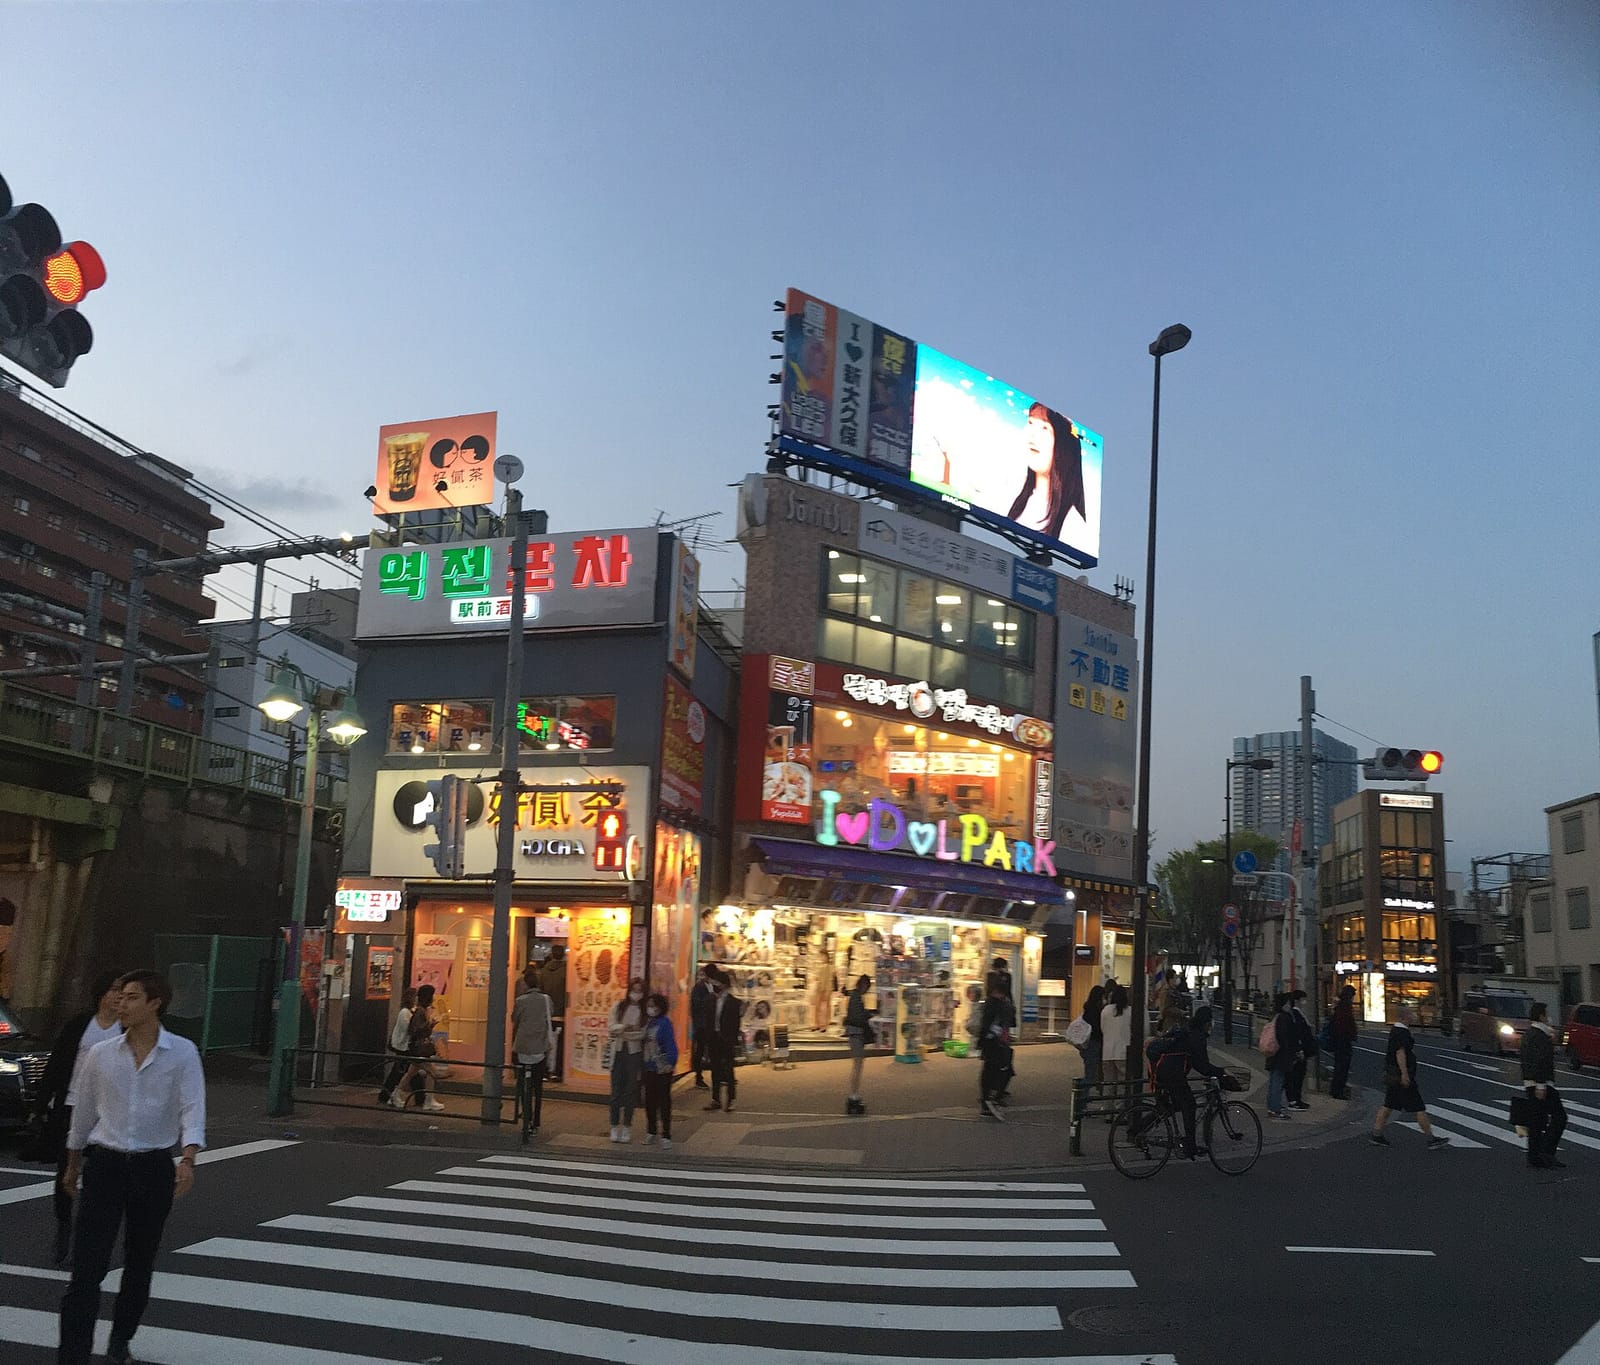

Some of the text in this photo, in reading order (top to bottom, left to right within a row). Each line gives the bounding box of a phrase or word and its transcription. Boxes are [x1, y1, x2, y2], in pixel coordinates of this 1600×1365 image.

[379, 534, 632, 600] 역전포차
[1069, 648, 1129, 692] 不動産
[520, 838, 586, 856] HOICHA
